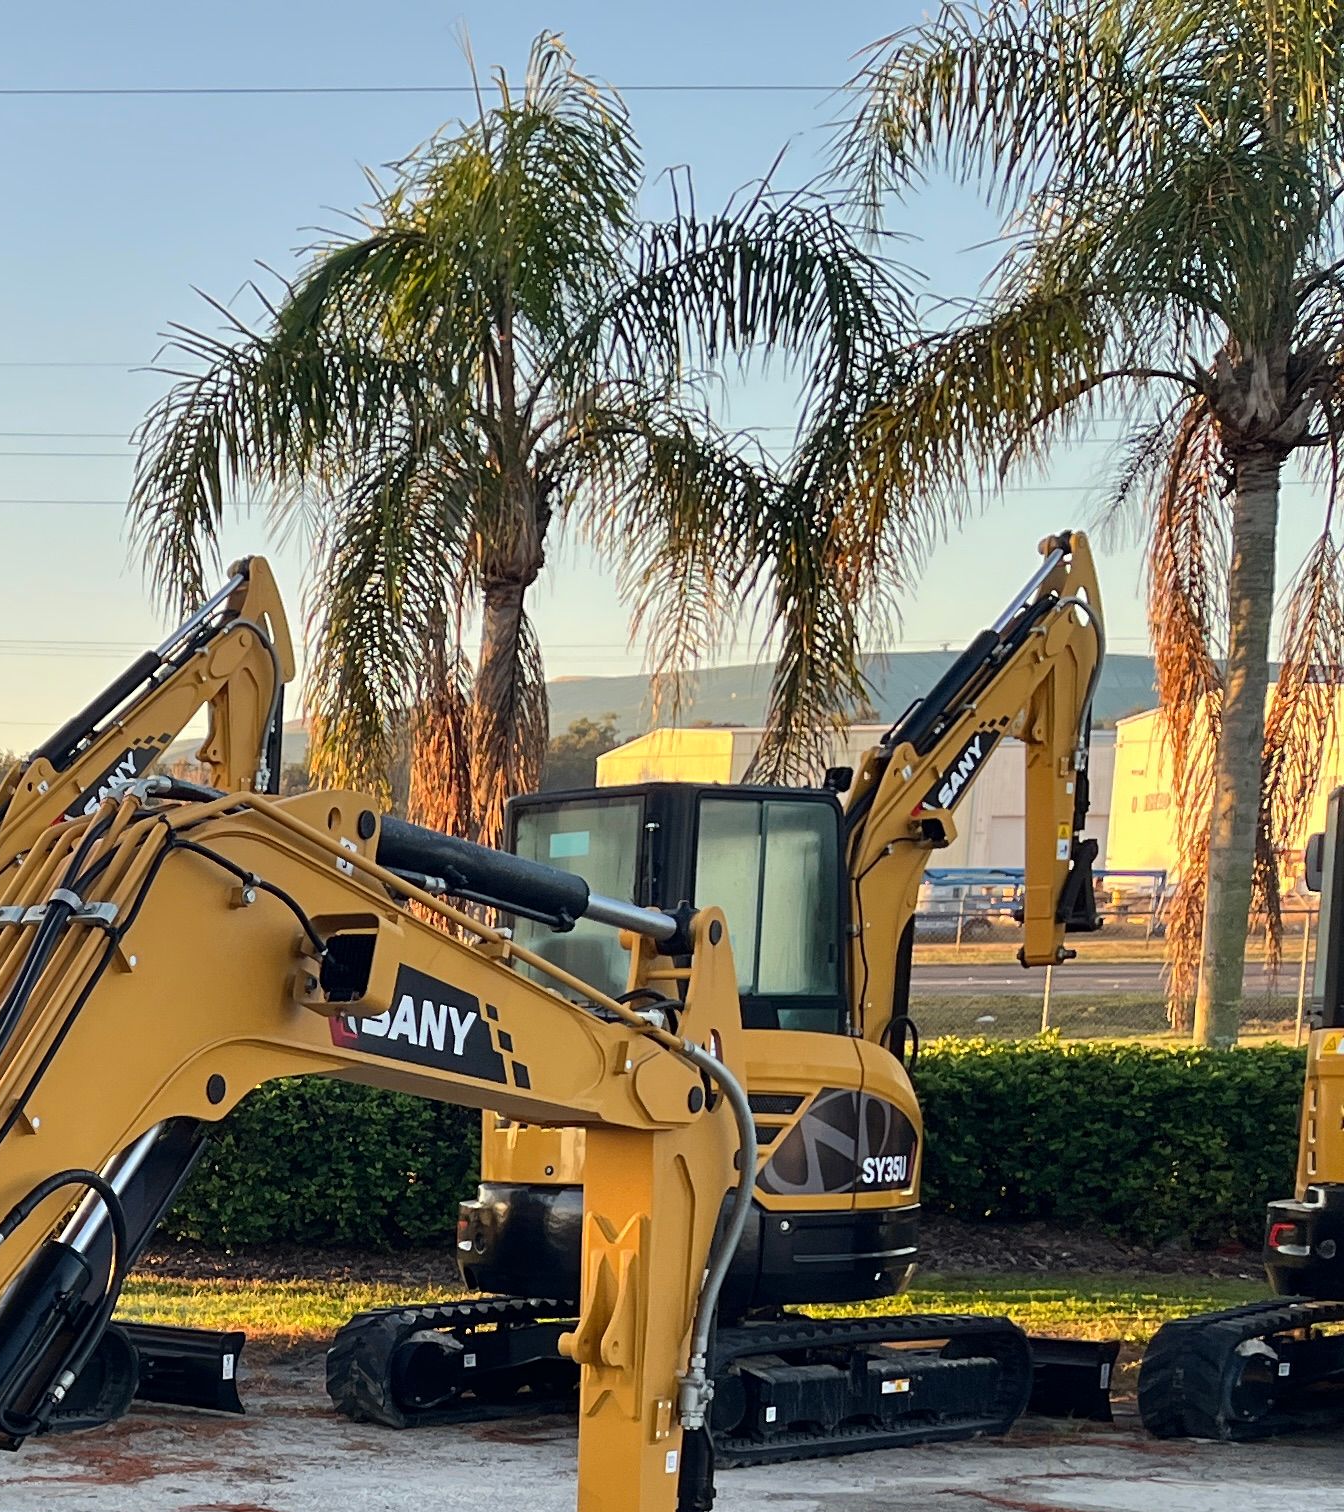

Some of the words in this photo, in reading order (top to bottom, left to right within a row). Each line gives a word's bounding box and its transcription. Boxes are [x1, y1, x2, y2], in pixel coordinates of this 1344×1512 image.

[938, 735, 982, 809] SANY
[362, 994, 478, 1056] SANY
[862, 1155, 907, 1184] SY35U
